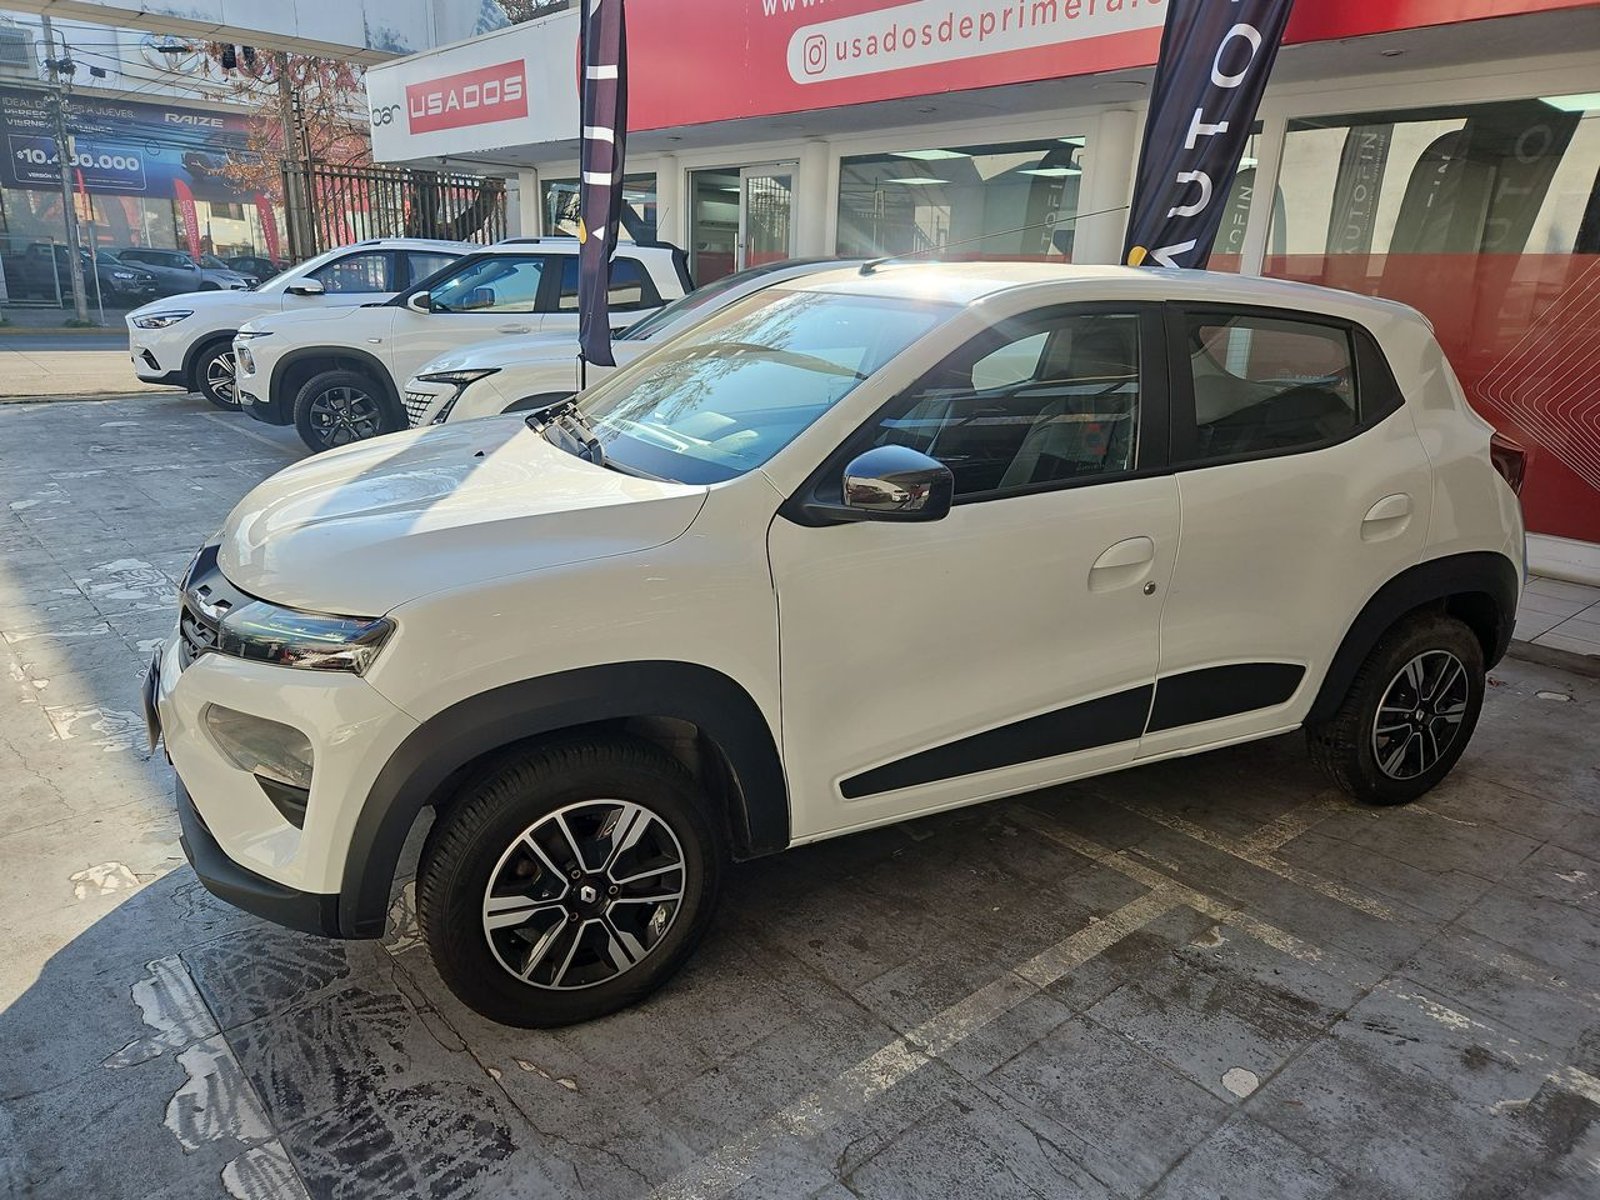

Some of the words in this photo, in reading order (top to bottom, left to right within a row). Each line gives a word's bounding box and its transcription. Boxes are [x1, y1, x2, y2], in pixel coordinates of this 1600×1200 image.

[836, 0, 1161, 60] usadosdeprimera.
[164, 113, 224, 128] RAIZE
[410, 75, 522, 118] USADOS
[1150, 0, 1262, 269] AUTO
